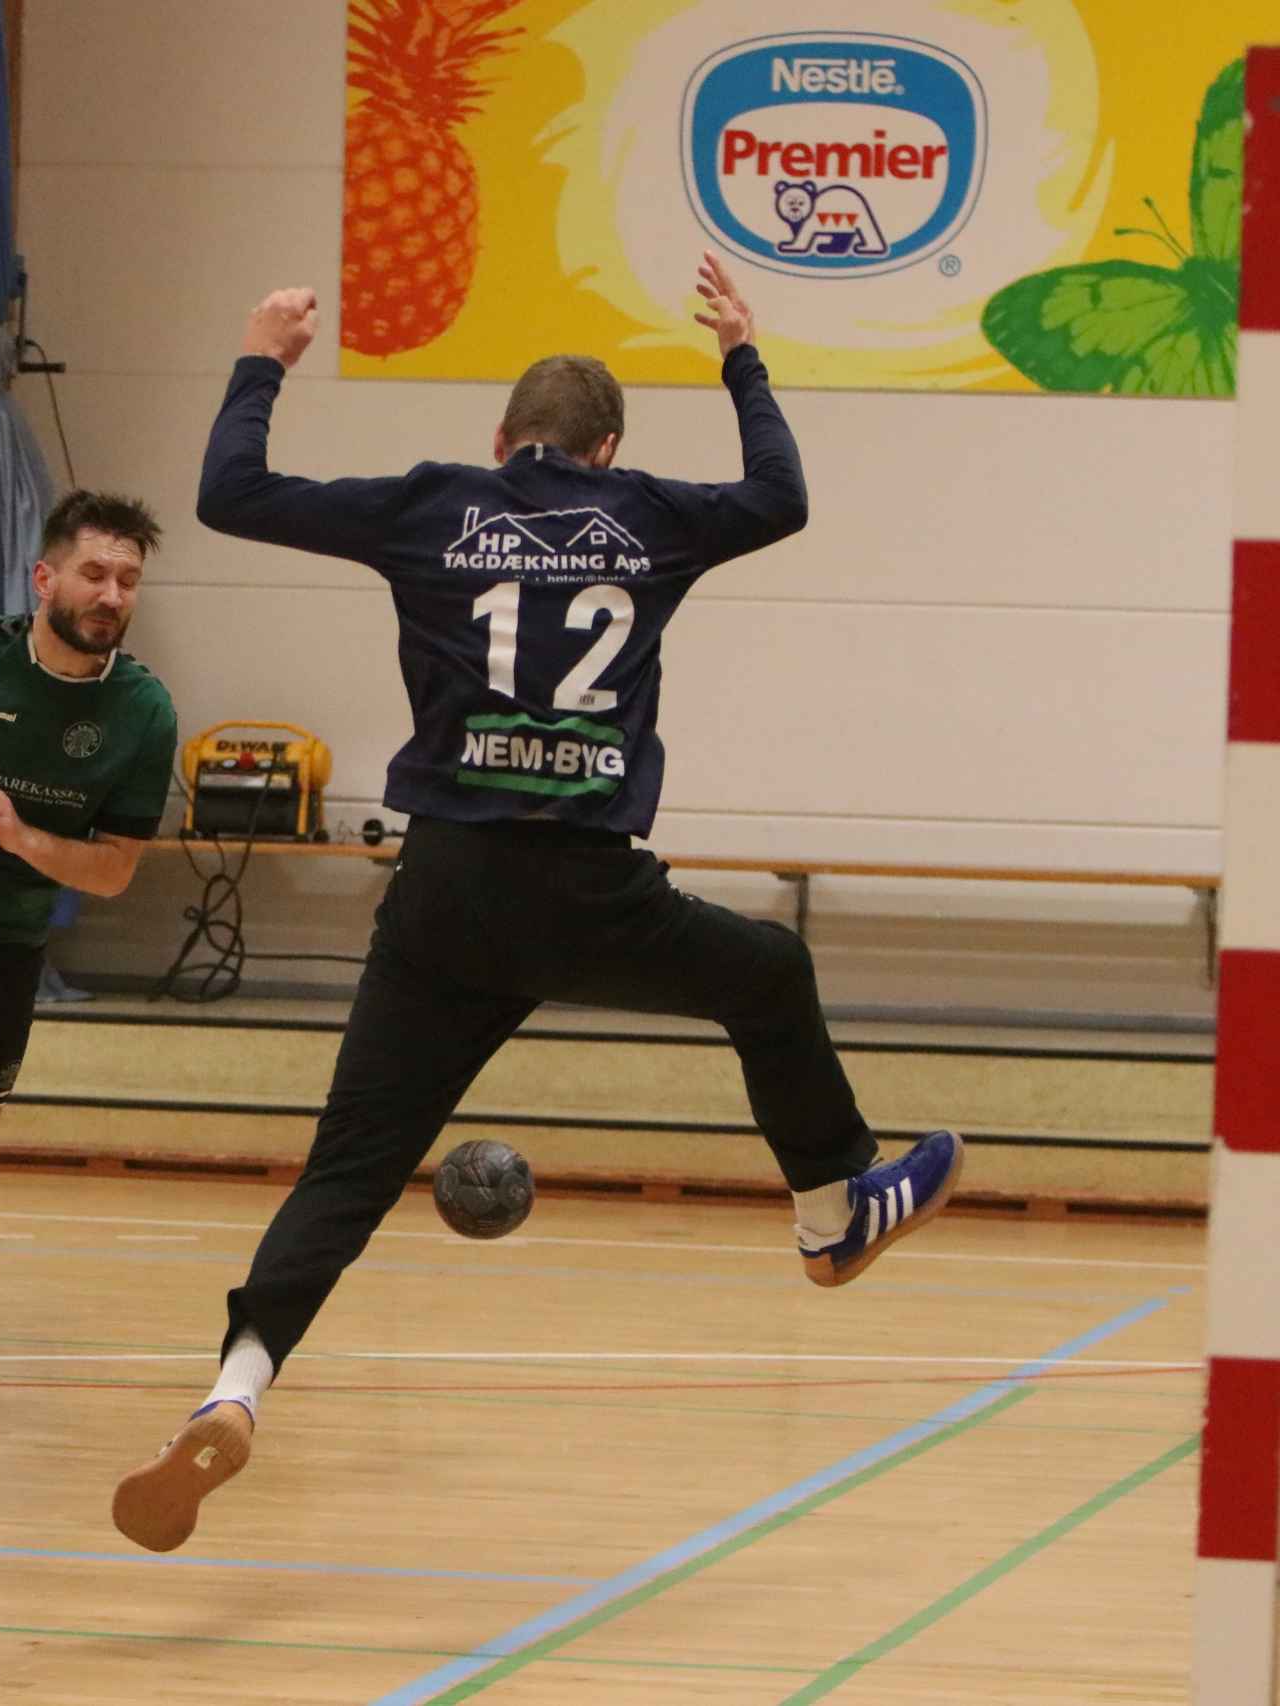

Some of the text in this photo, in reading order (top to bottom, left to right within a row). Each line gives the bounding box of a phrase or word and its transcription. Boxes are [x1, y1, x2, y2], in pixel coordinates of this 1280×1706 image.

[722, 129, 947, 179] Premier
[478, 532, 522, 553] HP
[443, 552, 606, 571] TAGDÆKNING
[472, 581, 635, 712] 12
